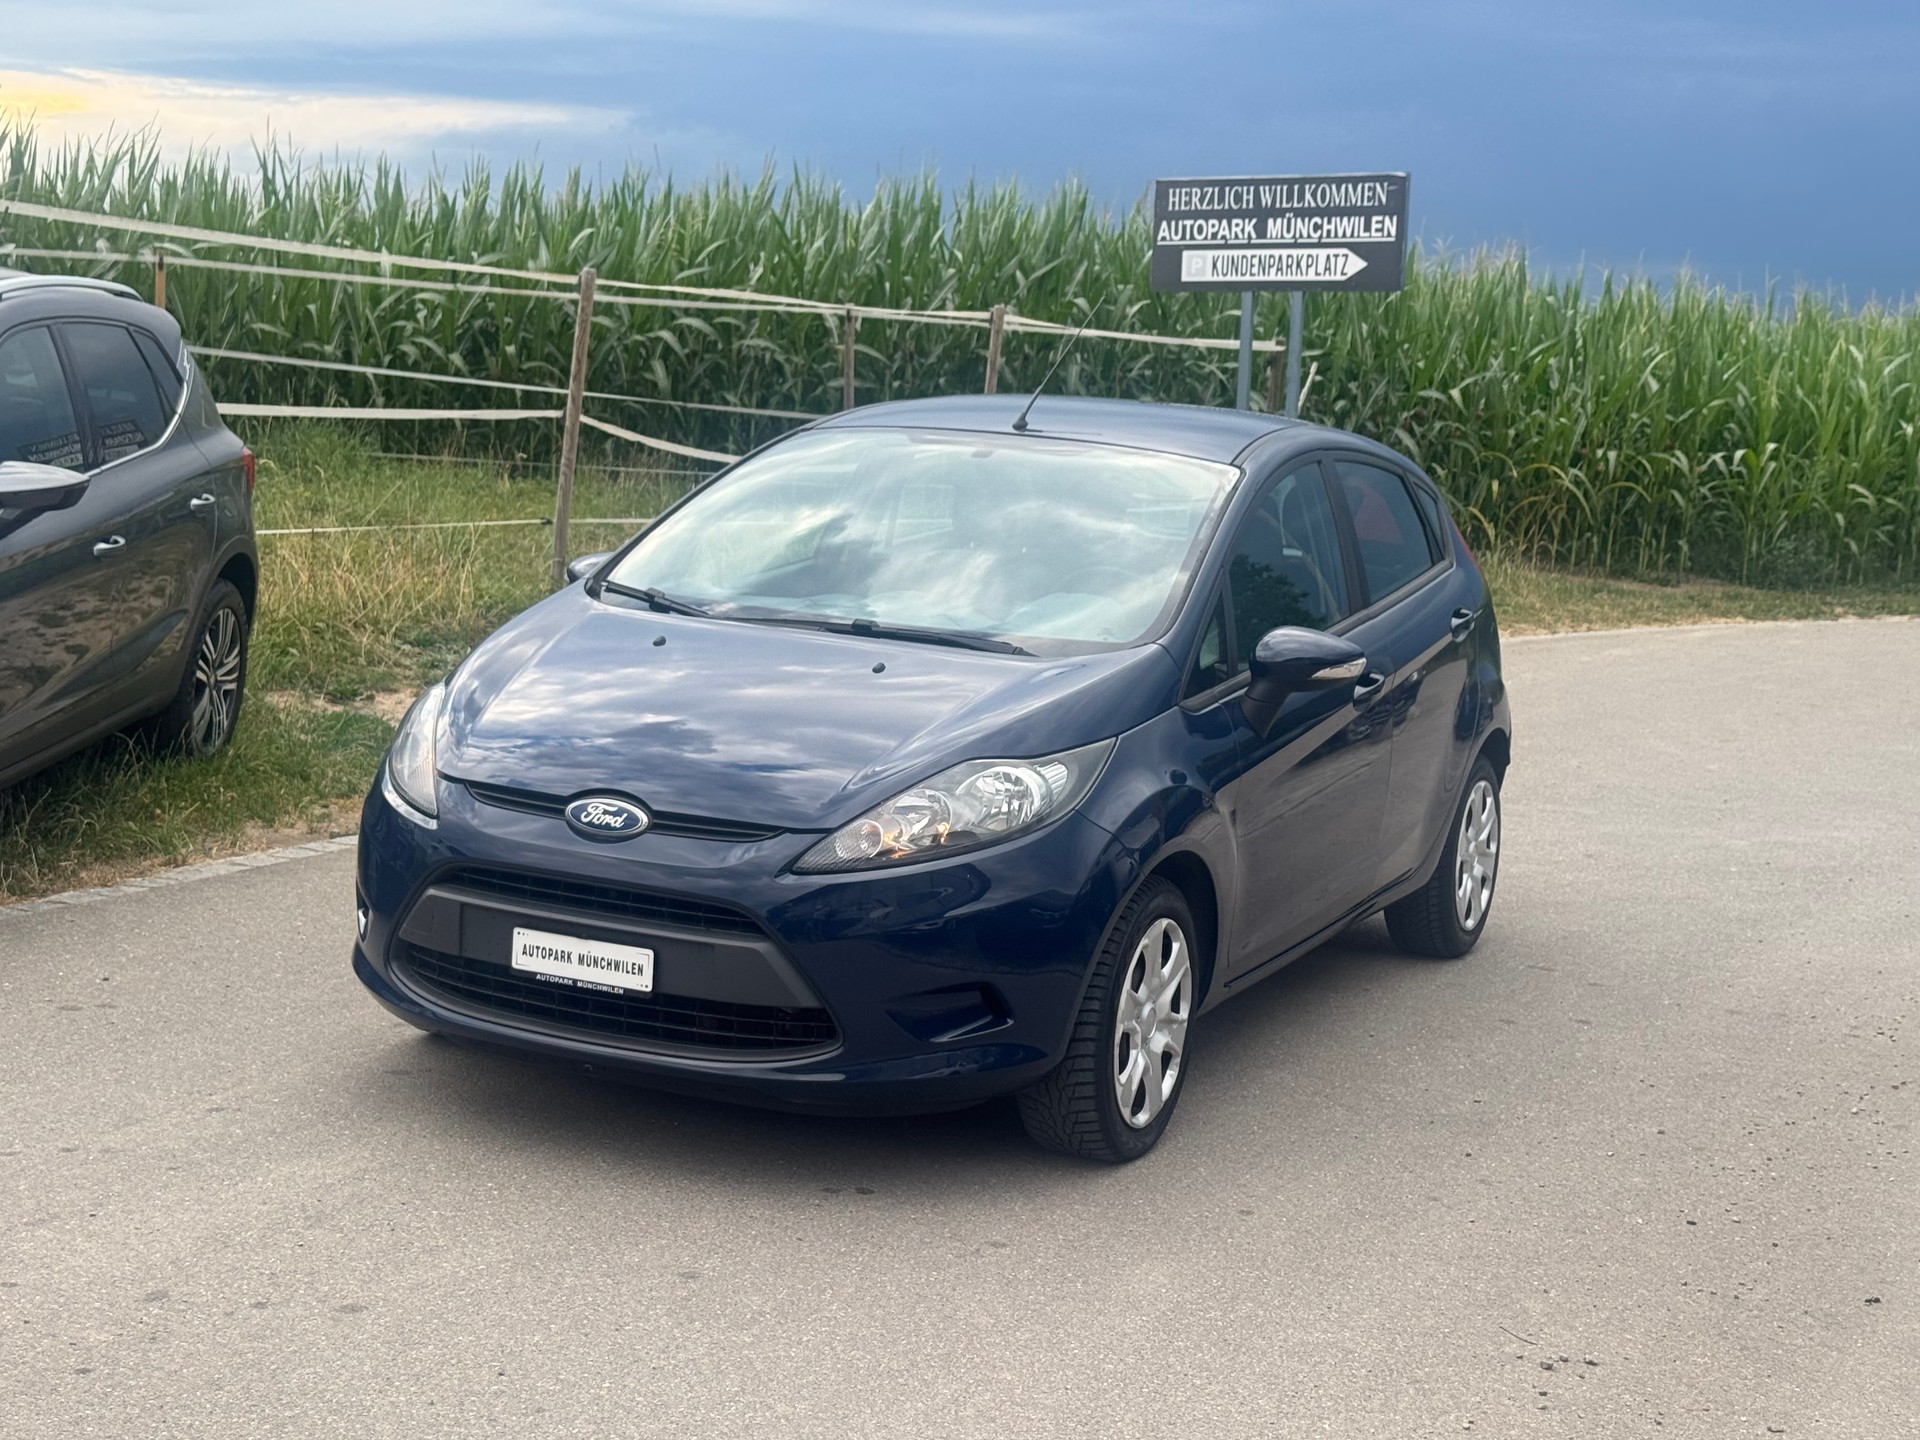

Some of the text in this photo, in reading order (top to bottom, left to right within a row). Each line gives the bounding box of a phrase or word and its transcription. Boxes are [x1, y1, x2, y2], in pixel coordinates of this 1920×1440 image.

[1168, 182, 1389, 211] HERZLICH WILLKOMMEN
[1157, 212, 1397, 241] AUTOPARK MÜNCHWILEN
[1211, 253, 1349, 278] KUNDENPARKPLATZ
[580, 802, 628, 828] Ford
[521, 943, 644, 977] AUTOPARK MÜNCHWILEN
[536, 973, 574, 986] AUTOPARK
